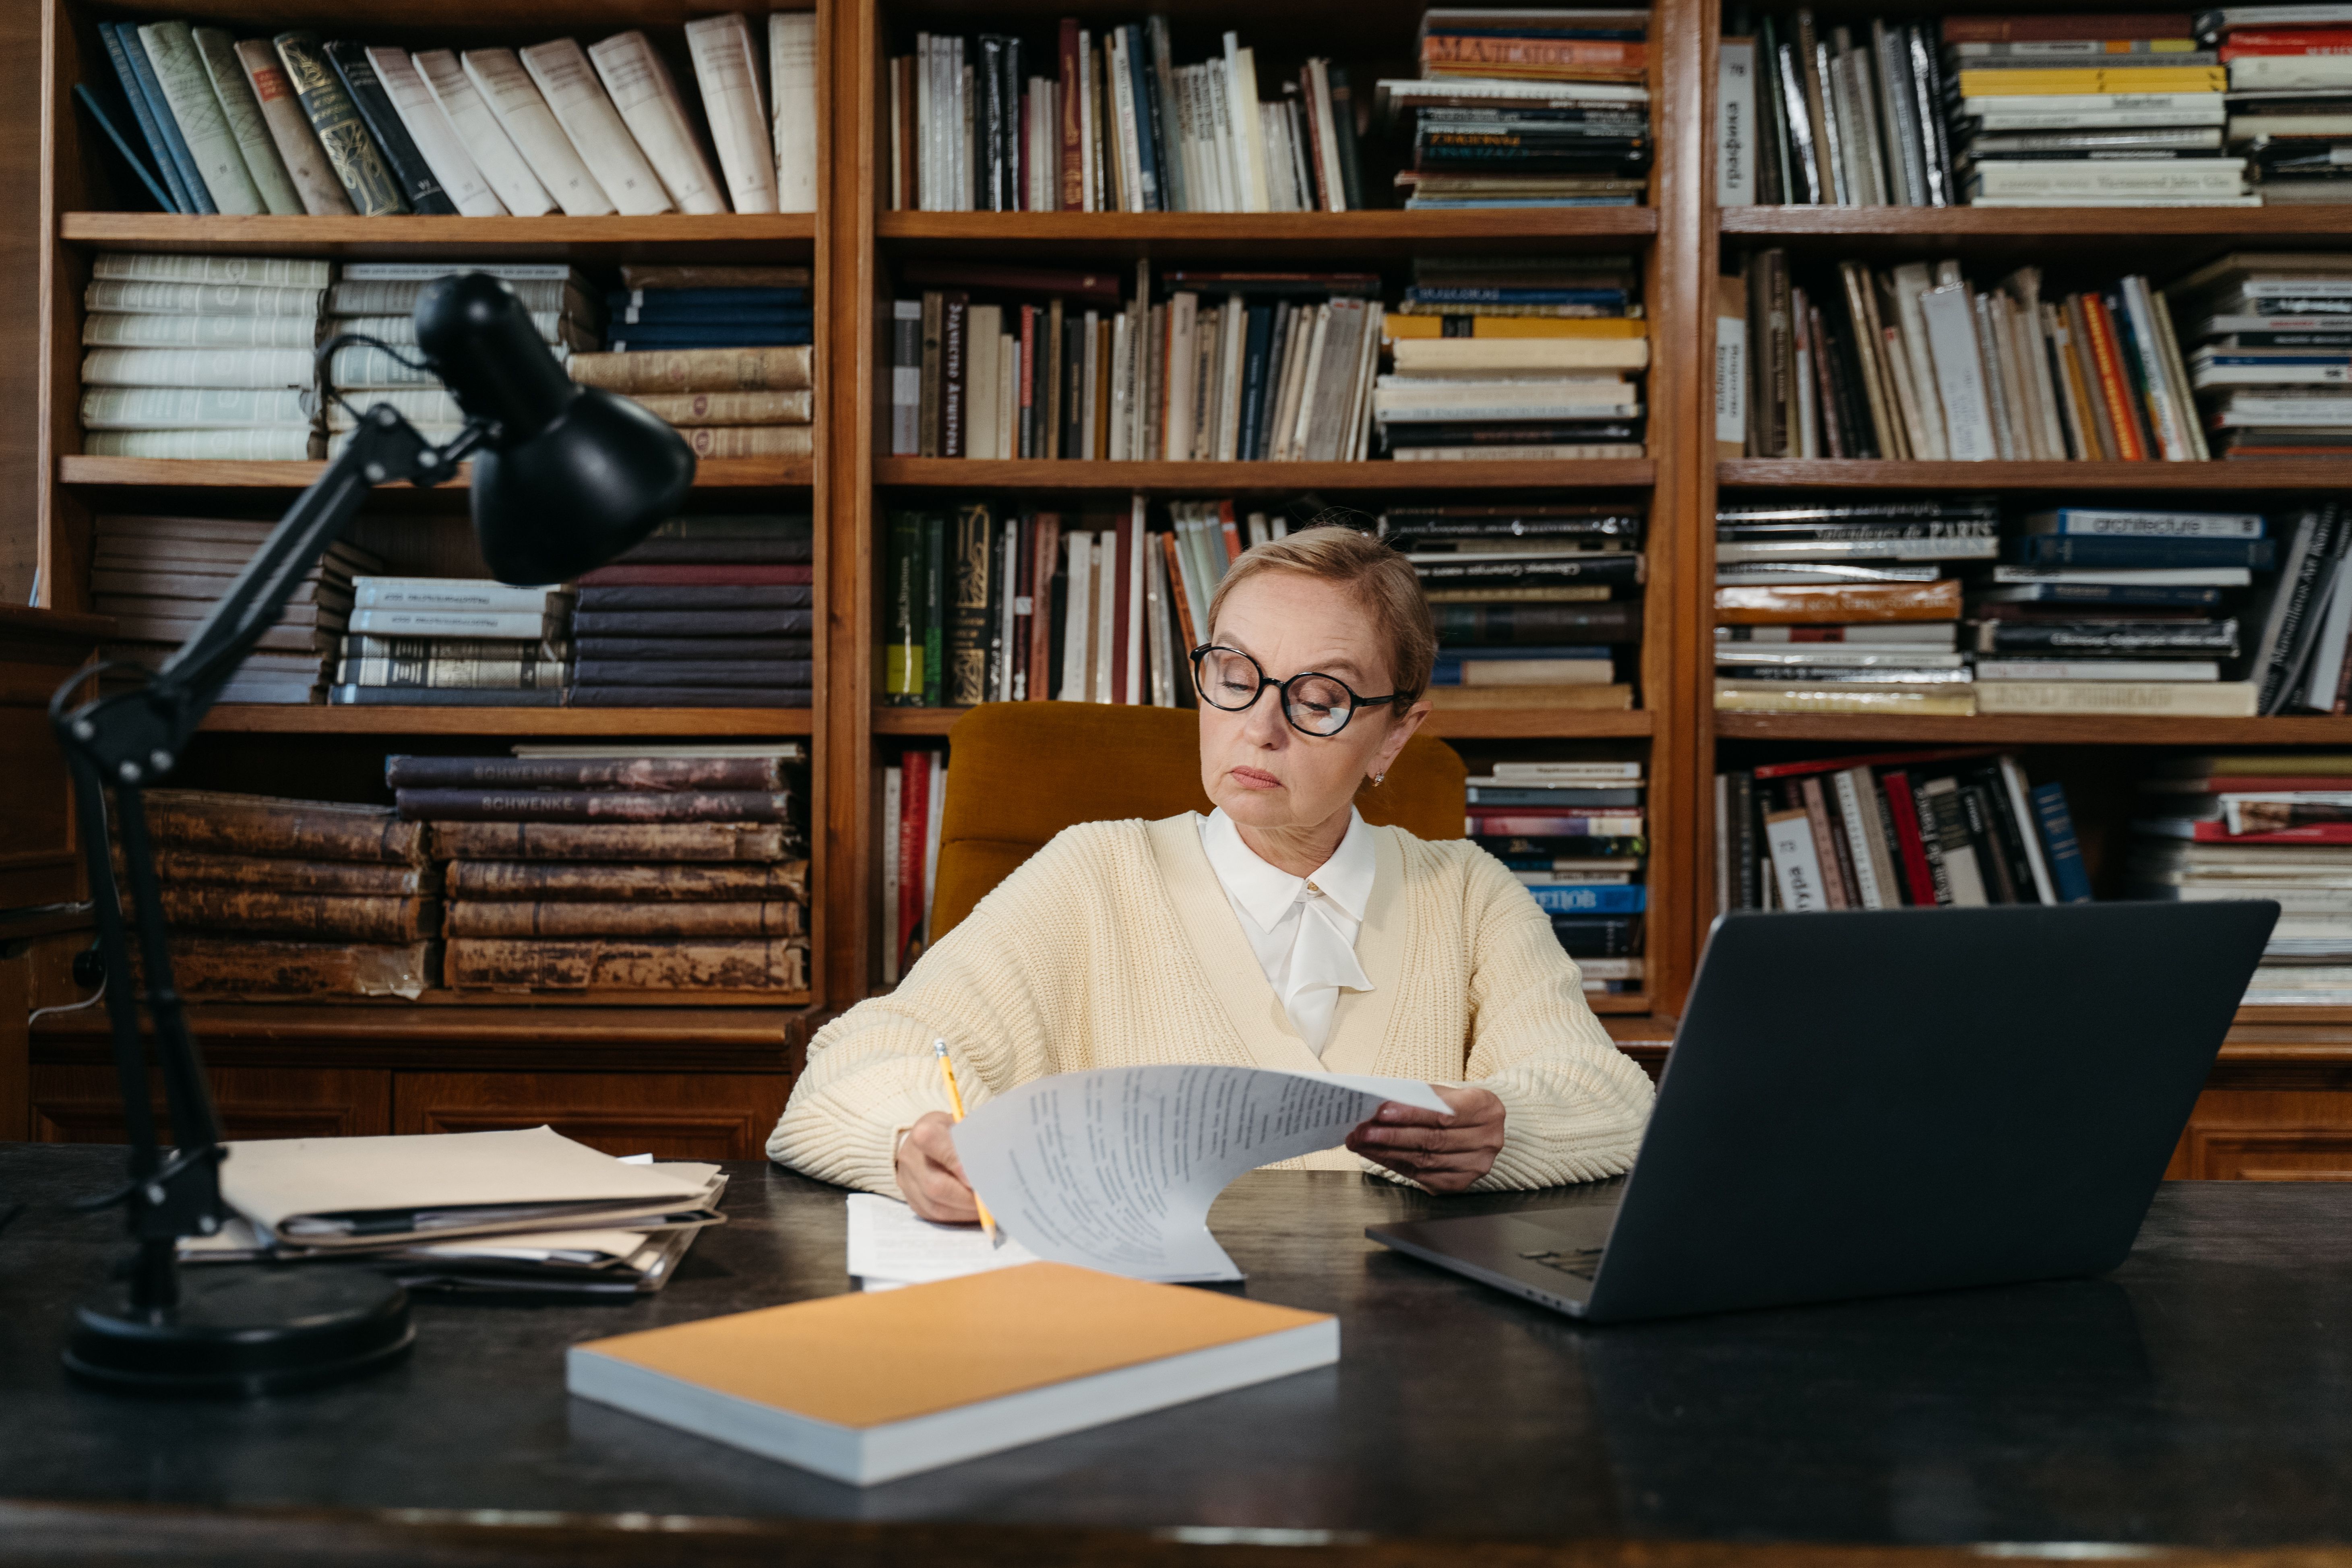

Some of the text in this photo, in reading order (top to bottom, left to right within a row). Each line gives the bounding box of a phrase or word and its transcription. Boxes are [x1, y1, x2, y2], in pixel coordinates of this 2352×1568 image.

[1725, 102, 1741, 189] графика
[945, 303, 963, 379] Зодчество
[1928, 521, 1994, 539] PARIS
[2094, 515, 2200, 535] architecture
[483, 796, 576, 812] SCHWENKE
